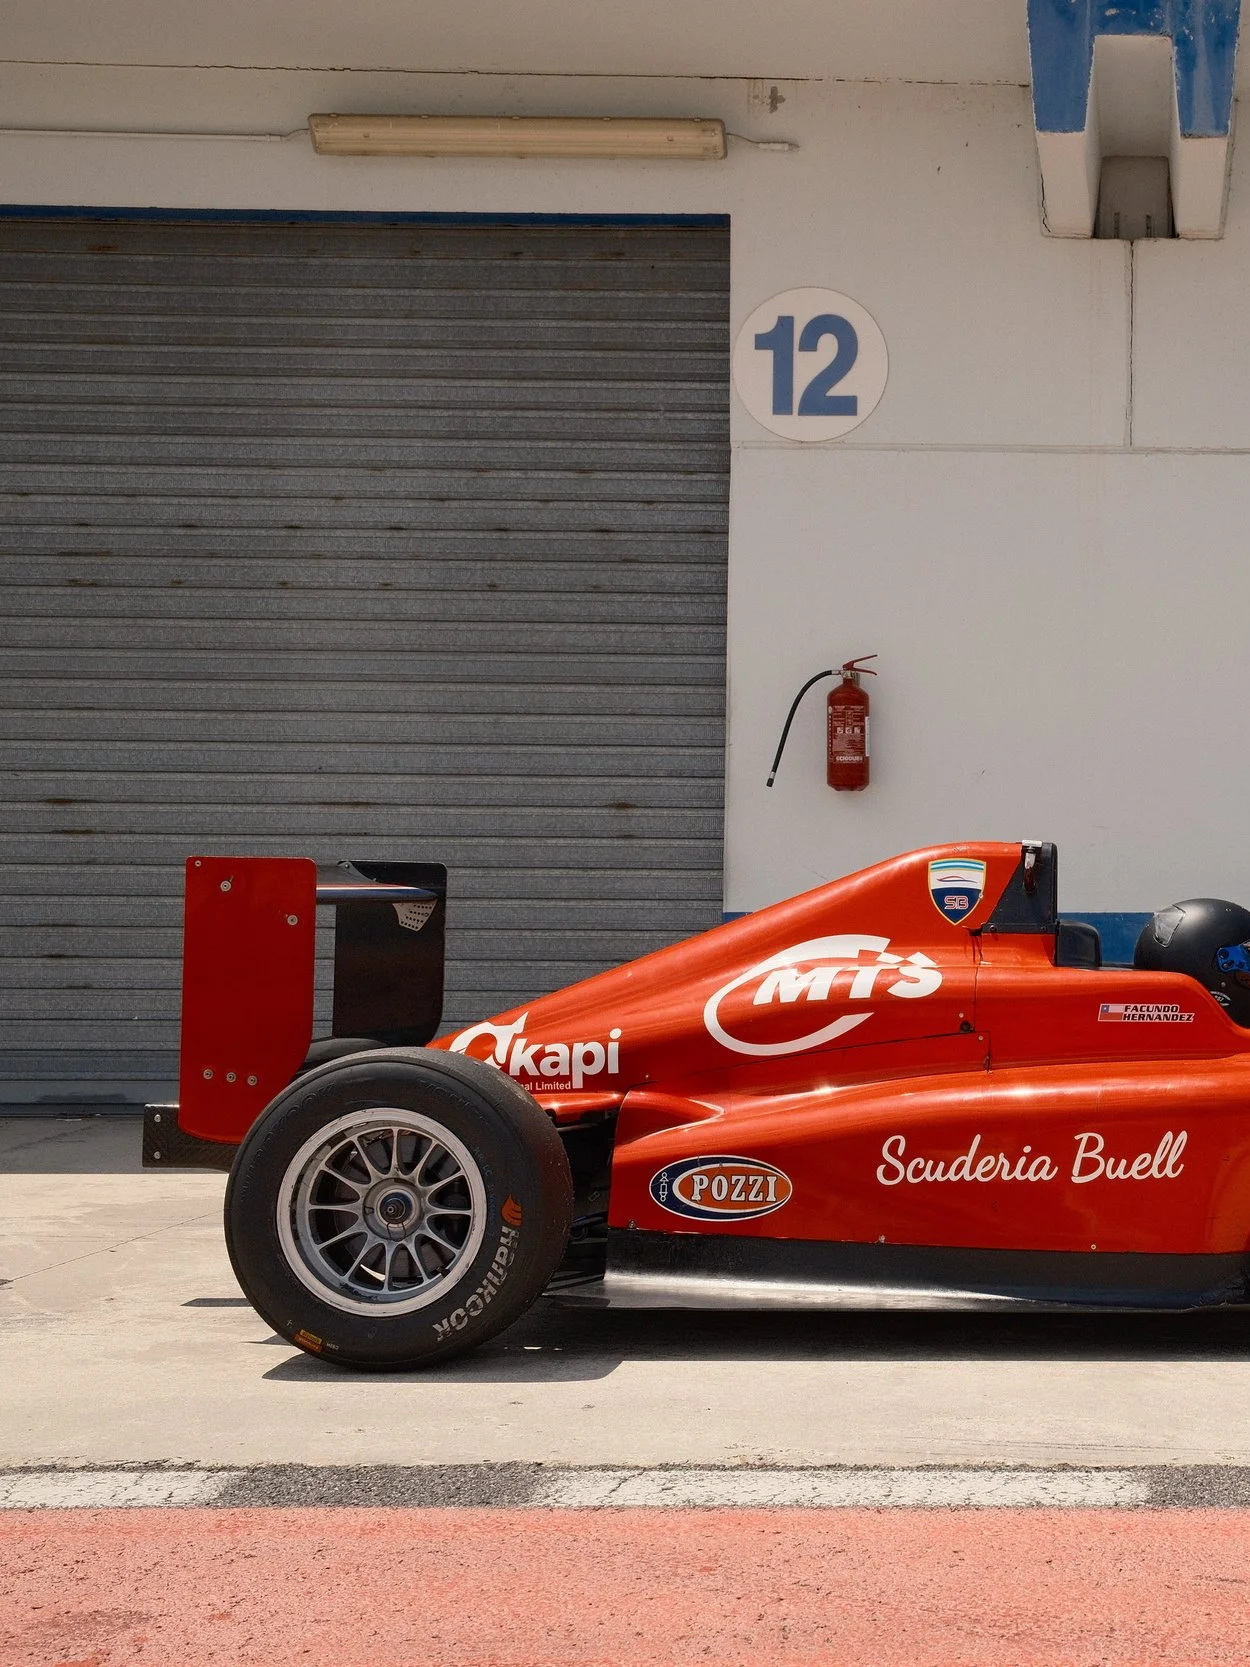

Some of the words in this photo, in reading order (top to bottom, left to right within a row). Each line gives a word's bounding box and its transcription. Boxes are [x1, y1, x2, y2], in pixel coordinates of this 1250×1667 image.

[754, 314, 858, 416] 12
[943, 895, 969, 910] SB
[753, 964, 943, 1006] MTS
[1123, 1013, 1194, 1022] HERNANDEZ
[1124, 1004, 1179, 1013] FACUNDO
[535, 1081, 571, 1092] Limited
[876, 1134, 1058, 1186] Scuderia
[1071, 1130, 1188, 1184] Buell
[691, 1174, 777, 1202] POZZI
